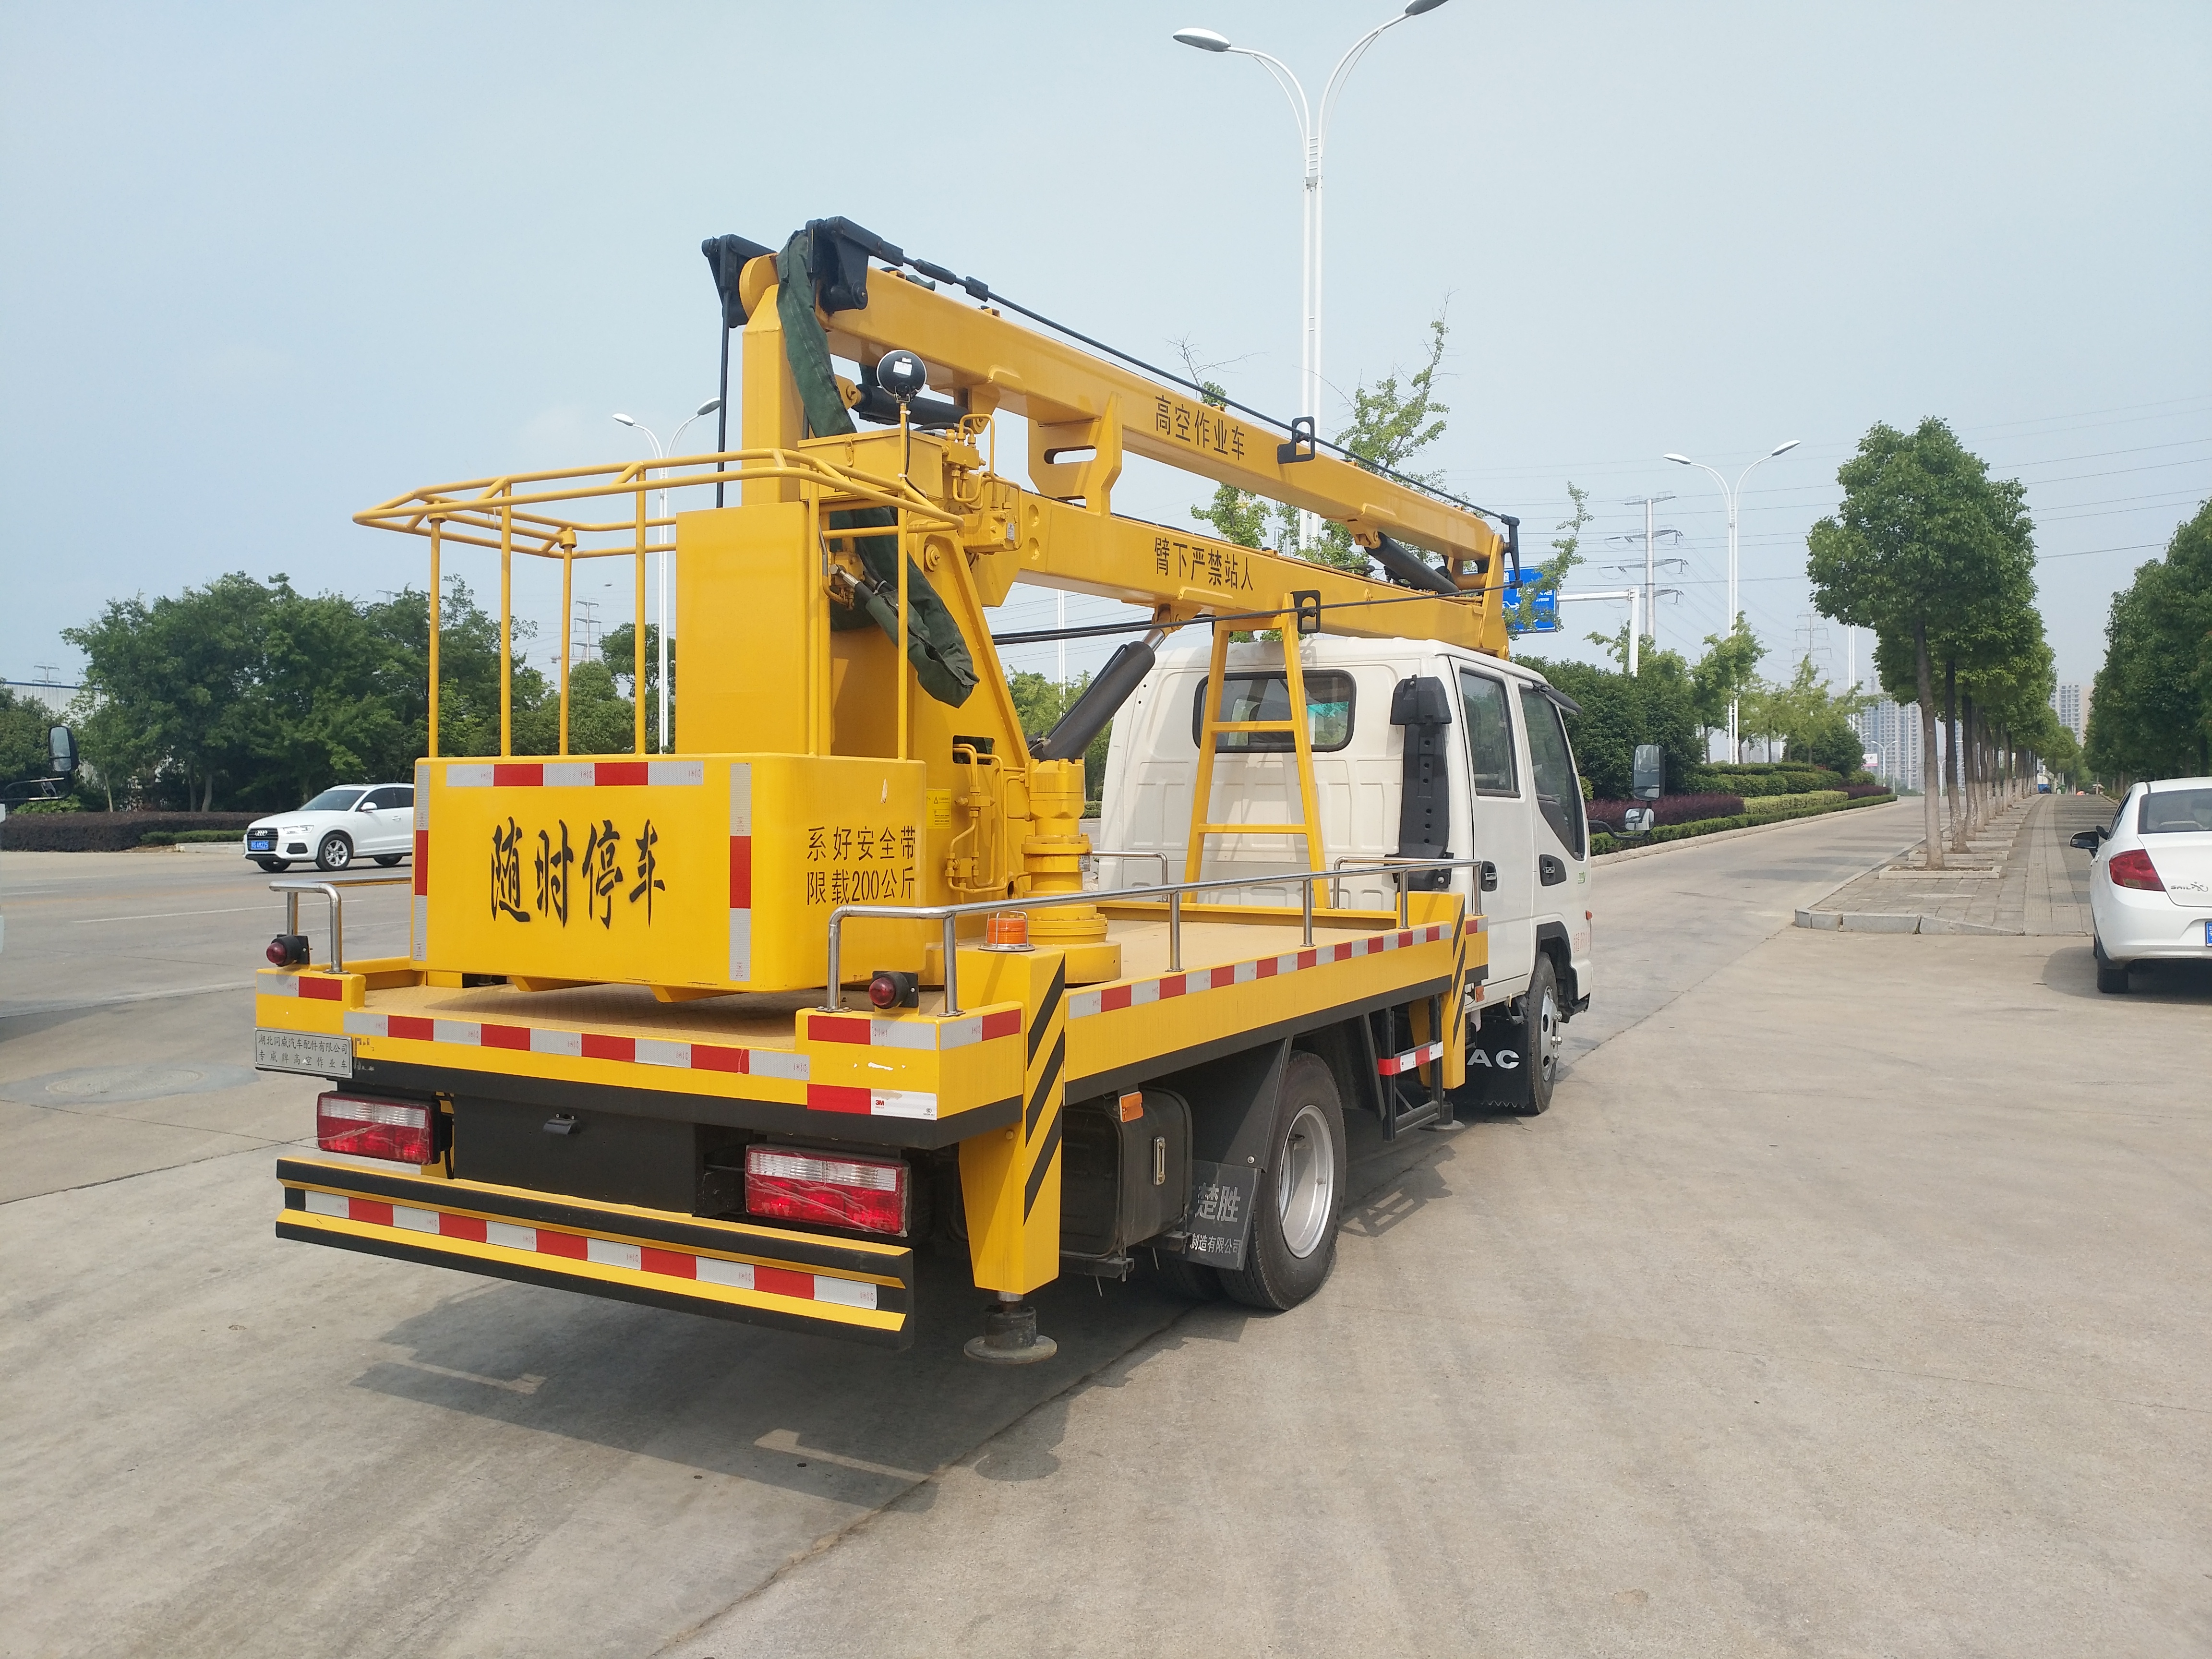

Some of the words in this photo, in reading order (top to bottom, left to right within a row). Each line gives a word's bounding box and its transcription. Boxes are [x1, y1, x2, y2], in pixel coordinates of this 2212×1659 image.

[1155, 395, 1245, 461] 高空作业车
[1154, 537, 1254, 591] 臂下严禁站人
[807, 825, 915, 861] 系好安全带
[491, 816, 666, 930] 随时停车
[807, 866, 915, 905] 限载200公斤
[1190, 1232, 1241, 1254] 制造有限公司
